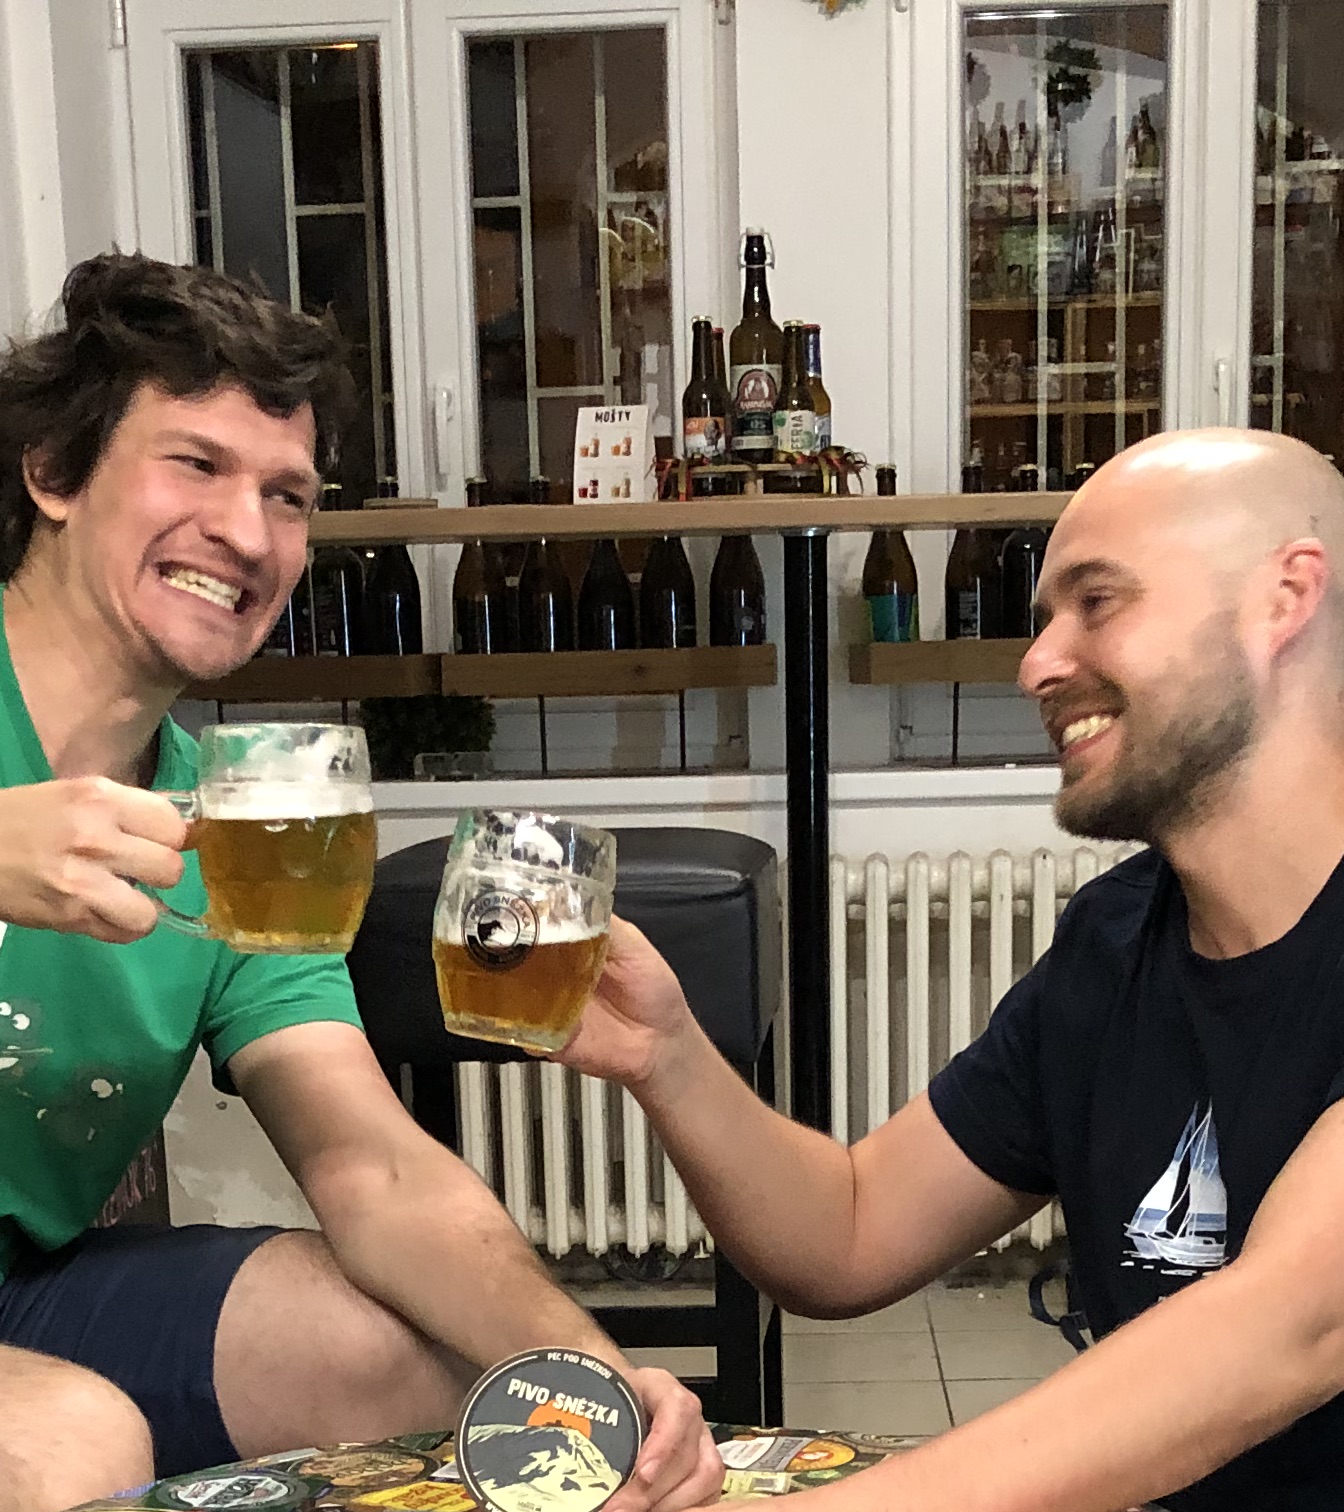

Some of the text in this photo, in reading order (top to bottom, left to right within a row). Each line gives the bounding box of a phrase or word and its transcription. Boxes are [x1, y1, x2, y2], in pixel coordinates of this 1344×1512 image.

[547, 1352, 562, 1361] PEC
[563, 1353, 579, 1365] POD
[507, 1378, 620, 1427] PIVO SNĚŽKA
